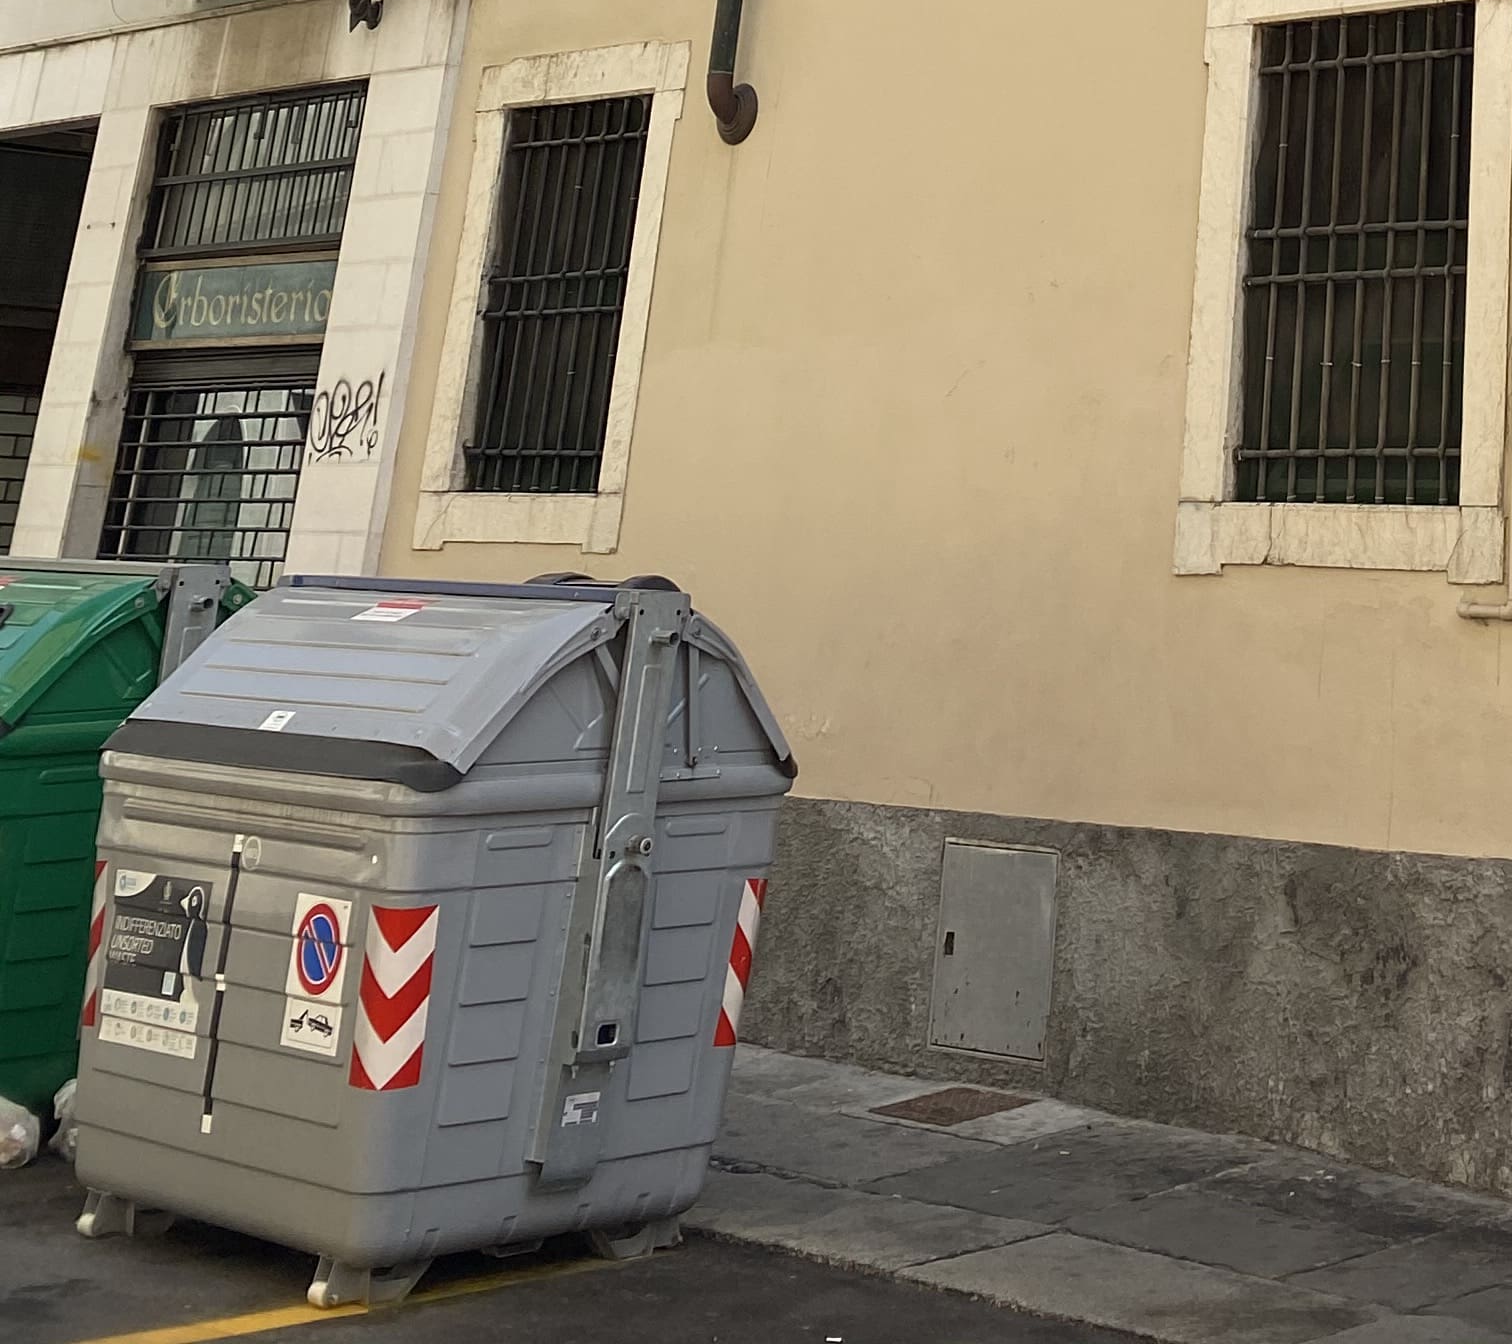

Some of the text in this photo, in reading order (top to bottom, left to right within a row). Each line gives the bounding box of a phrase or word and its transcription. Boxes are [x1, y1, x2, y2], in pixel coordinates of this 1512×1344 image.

[153, 271, 332, 328] Erboristeria
[115, 915, 182, 940] INDIFFERENZIATO
[111, 934, 154, 954] UNSORTED
